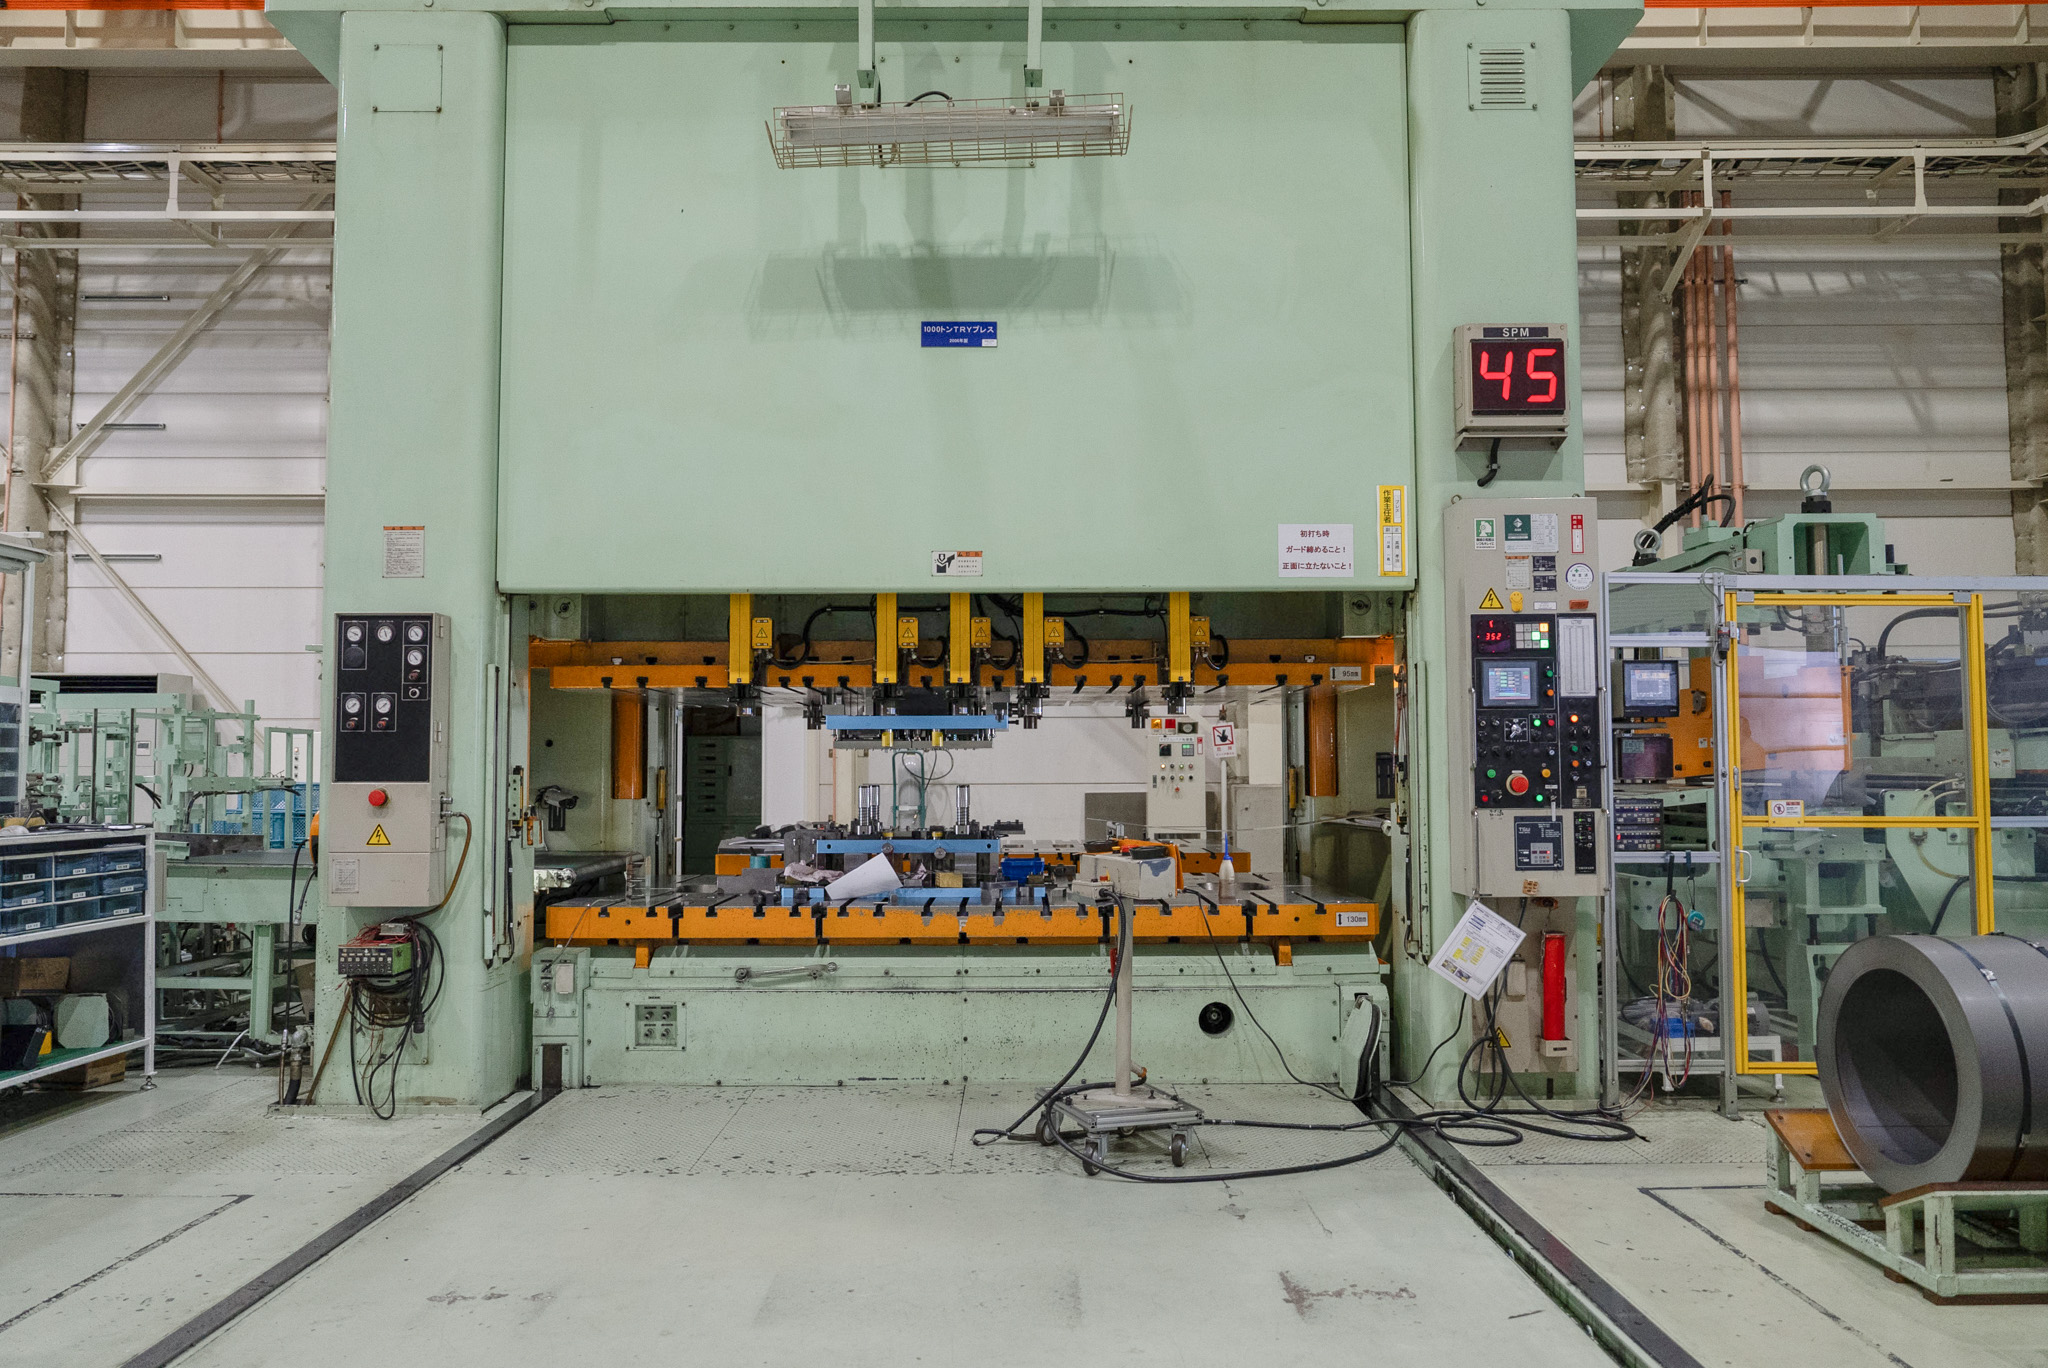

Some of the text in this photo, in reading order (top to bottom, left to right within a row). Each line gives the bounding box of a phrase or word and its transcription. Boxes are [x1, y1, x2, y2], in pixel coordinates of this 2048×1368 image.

[923, 325, 994, 333] 1000トンTRYプレス
[1502, 327, 1530, 337] SPM
[1479, 348, 1557, 403] 45
[1383, 489, 1391, 523] 作業主任者
[1282, 562, 1352, 570] 正面に立たないこと！
[1485, 632, 1502, 640] 352
